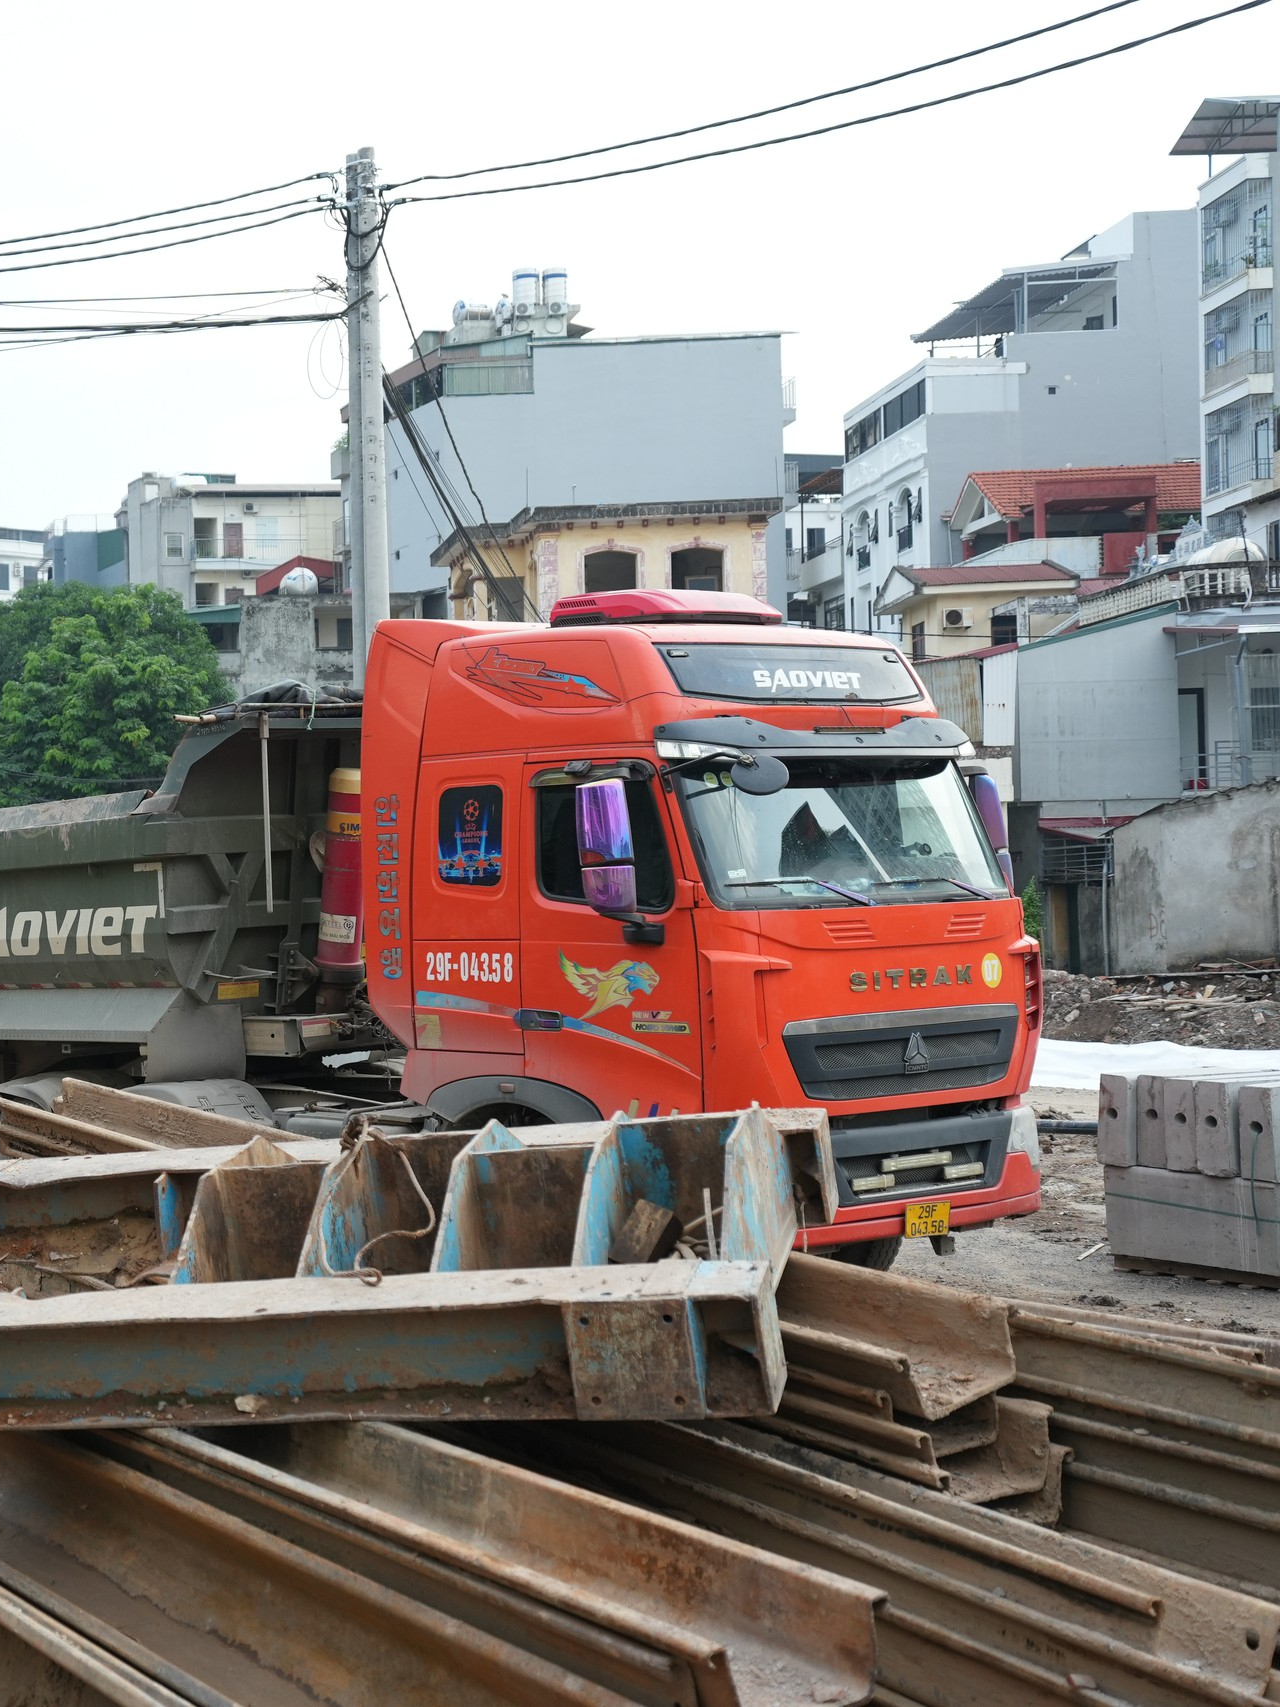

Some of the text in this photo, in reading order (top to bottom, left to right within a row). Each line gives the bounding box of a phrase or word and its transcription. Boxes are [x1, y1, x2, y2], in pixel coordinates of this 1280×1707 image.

[454, 830, 489, 838] CHAMPIONS
[984, 959, 999, 982] 07
[849, 964, 973, 992] SITRAK
[632, 1011, 650, 1019] NEW
[907, 1064, 929, 1072] CNHTC
[918, 1205, 937, 1219] 29F
[911, 1220, 944, 1236] 043.58
